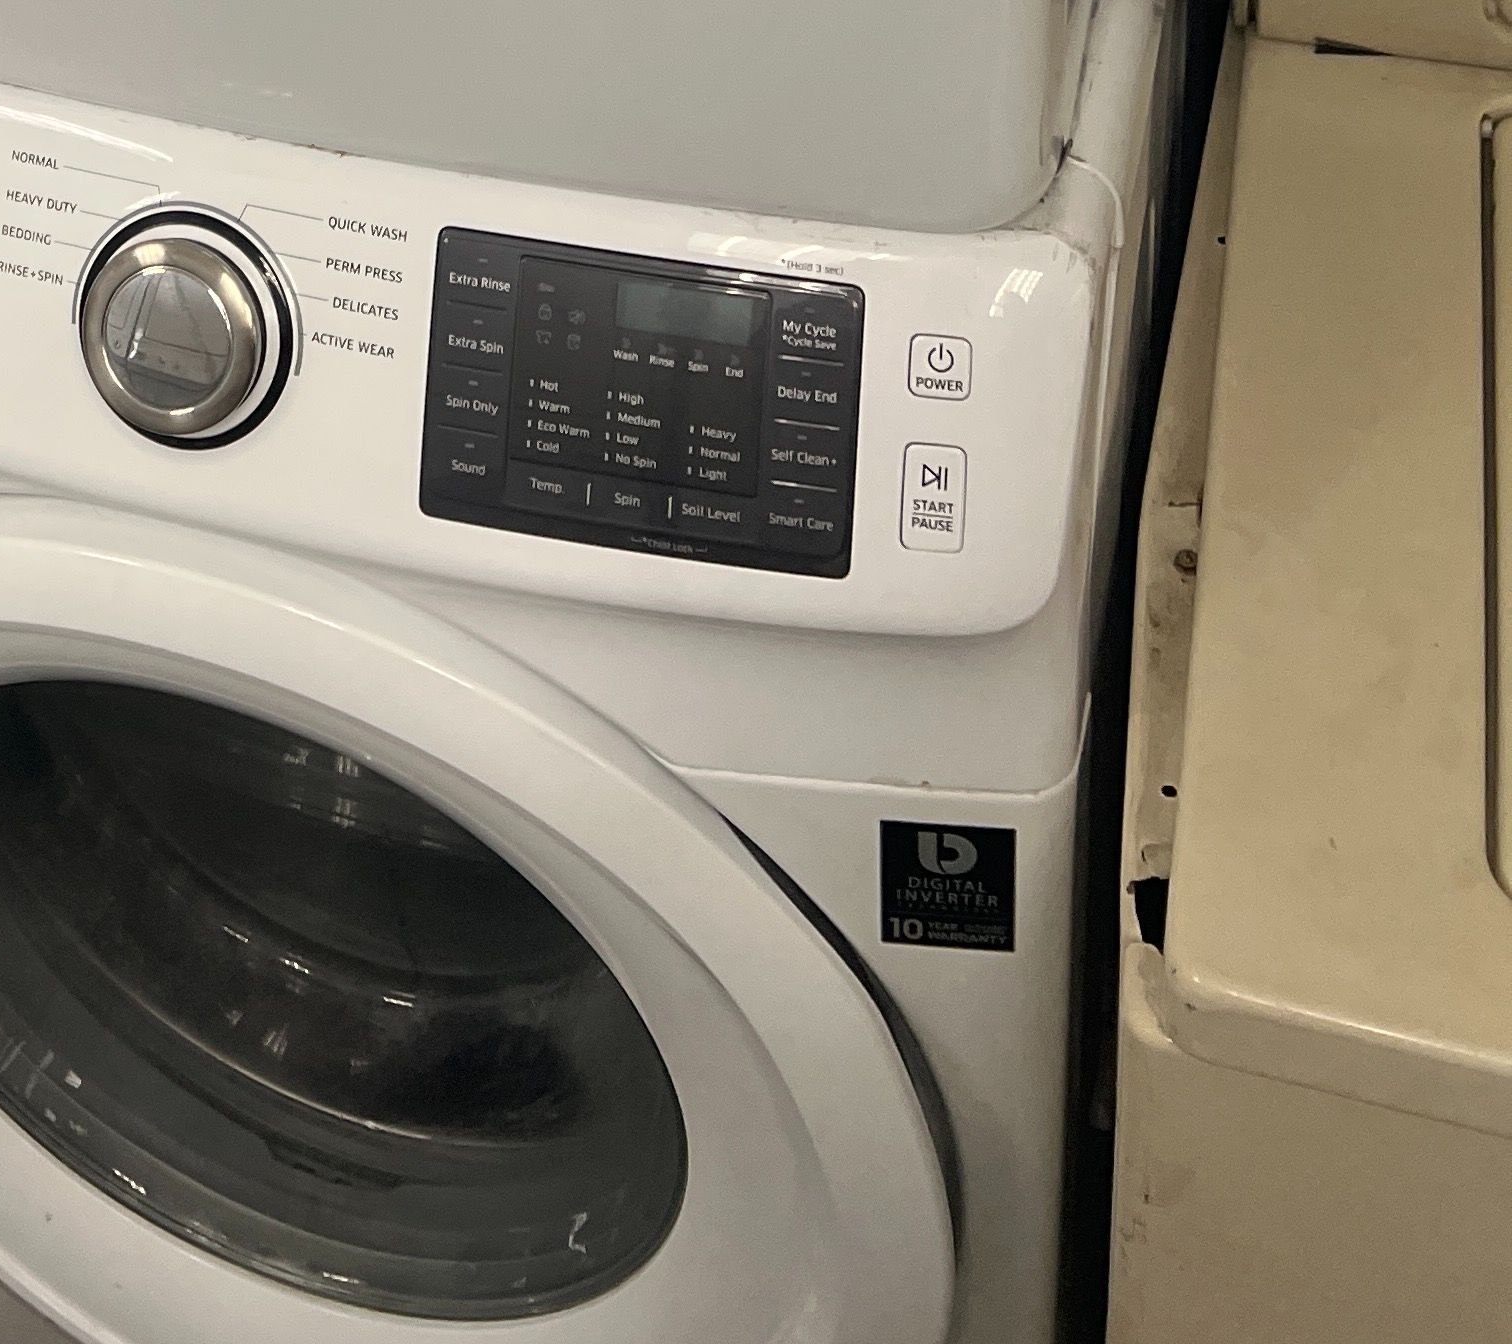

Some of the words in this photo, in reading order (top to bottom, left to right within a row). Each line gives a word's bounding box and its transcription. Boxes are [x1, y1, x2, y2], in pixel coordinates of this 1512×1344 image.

[11, 150, 59, 170] NORMAL
[6, 189, 43, 206] HEAVY
[46, 198, 78, 214] DUTY
[1, 224, 52, 246] BEDDING
[328, 216, 366, 234] QUICK
[370, 224, 408, 242] WASH
[325, 257, 361, 275] PERM
[364, 266, 403, 284] PRESS
[449, 272, 478, 287] Extra
[481, 277, 511, 293] Rinse
[332, 296, 399, 321] DELICATES
[783, 320, 802, 335] My
[804, 322, 837, 340] Cycle
[311, 332, 354, 351] ACTIVE
[358, 340, 395, 359] WEAR
[448, 334, 477, 350] Extra
[479, 340, 504, 355] Spin
[613, 349, 639, 362] Wash
[725, 366, 744, 378] End
[540, 379, 559, 392] Hot
[915, 376, 964, 393] POWER
[618, 392, 644, 406] High
[777, 386, 812, 403] Delay
[815, 390, 837, 404] End
[446, 394, 470, 410] Spin
[472, 400, 499, 416] Only
[539, 400, 571, 414] Warm
[617, 412, 661, 429] Medium
[537, 420, 557, 433] Eco
[559, 424, 590, 439] Warm
[701, 426, 737, 443] Heavy
[536, 441, 560, 454] Cold
[616, 432, 639, 446] Low
[615, 453, 632, 466] No
[633, 455, 657, 470] Spin
[700, 447, 741, 463] Normal
[771, 449, 794, 462] Self
[451, 459, 486, 476] Sound
[699, 467, 727, 482] Light
[614, 492, 641, 507] Spin
[912, 499, 954, 514] START
[681, 503, 704, 517] Soil
[707, 507, 741, 523] Level
[768, 512, 804, 529] Smart
[806, 517, 834, 532] Care
[911, 516, 954, 533] PAUSE
[908, 876, 987, 893] DIGITAL
[896, 889, 999, 907] INVERTER
[889, 917, 924, 940] 10
